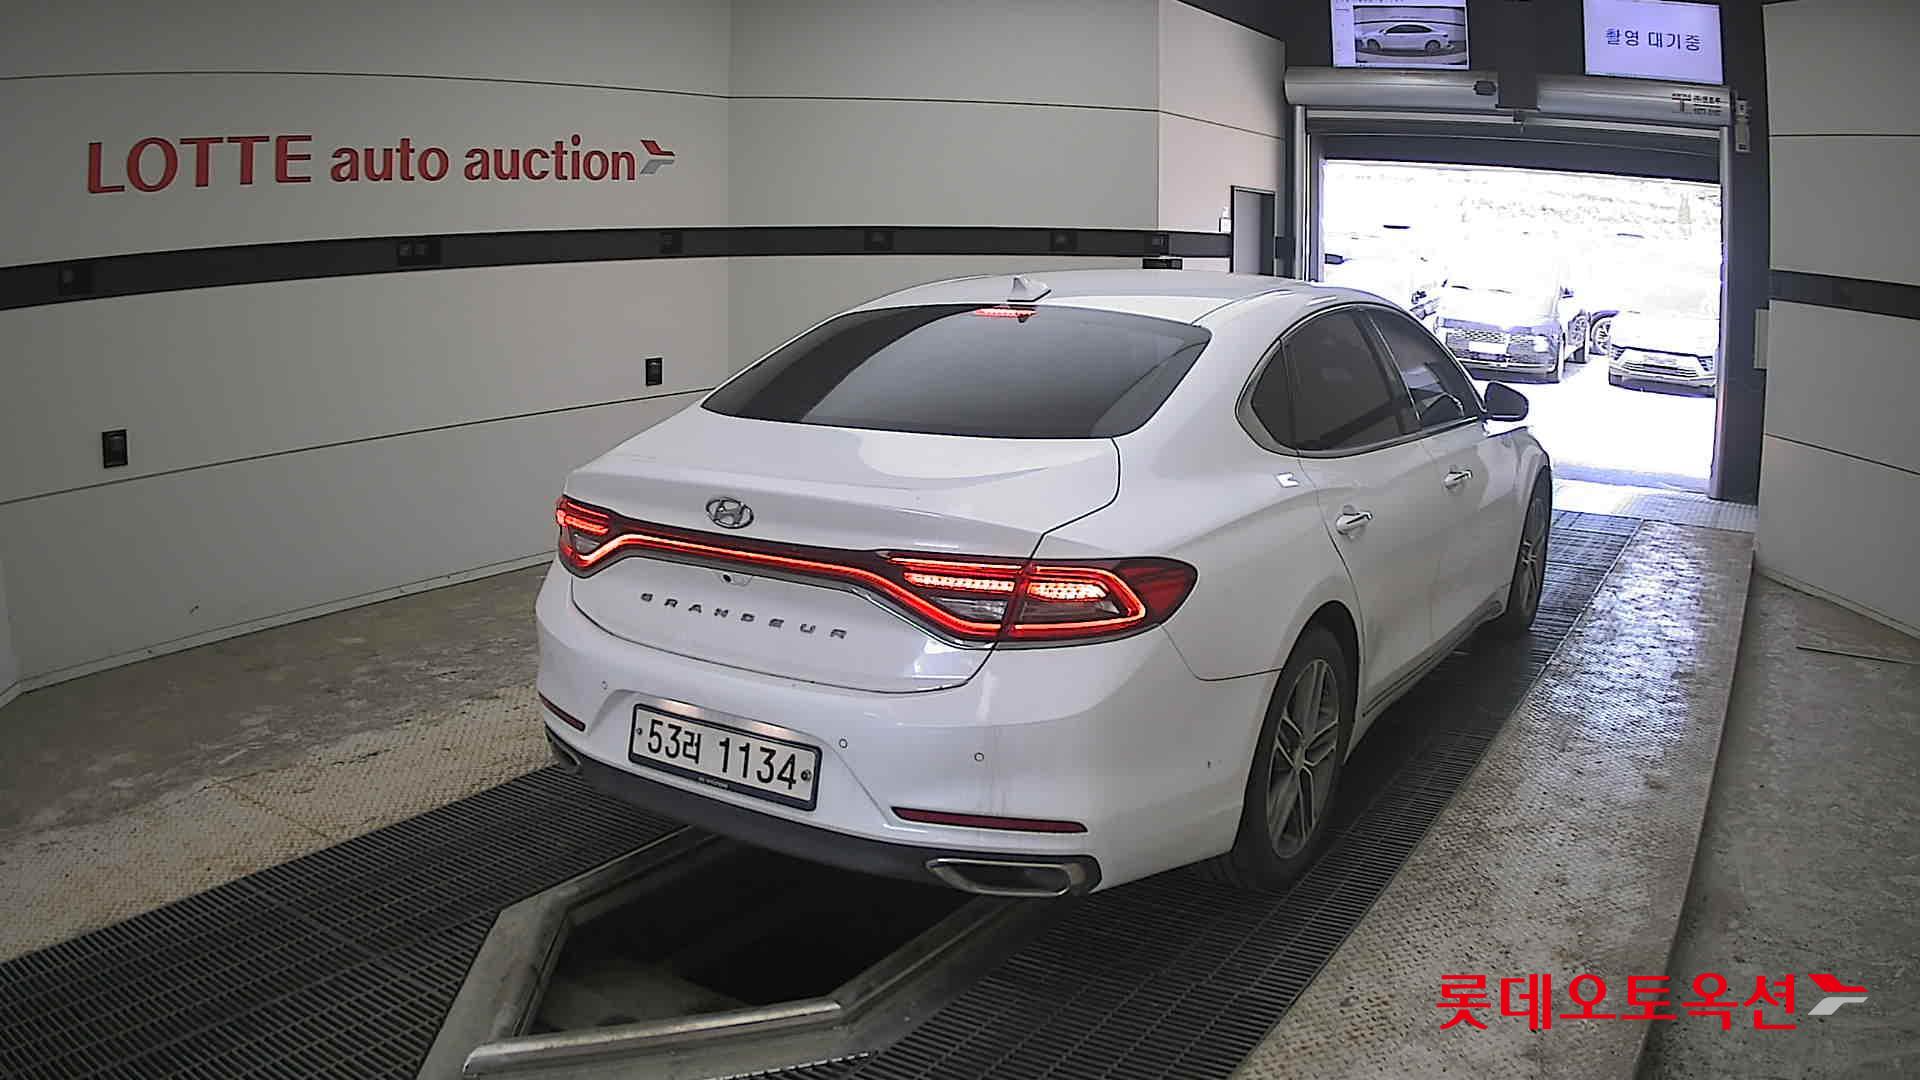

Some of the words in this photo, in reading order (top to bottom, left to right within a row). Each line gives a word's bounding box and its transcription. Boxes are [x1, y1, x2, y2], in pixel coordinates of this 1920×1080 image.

[87, 134, 312, 193] LOTTE
[330, 138, 449, 182] auto
[463, 134, 637, 181] auction
[640, 592, 848, 640] GRANDEUR
[647, 718, 702, 765] 53러
[718, 736, 797, 791] 1134
